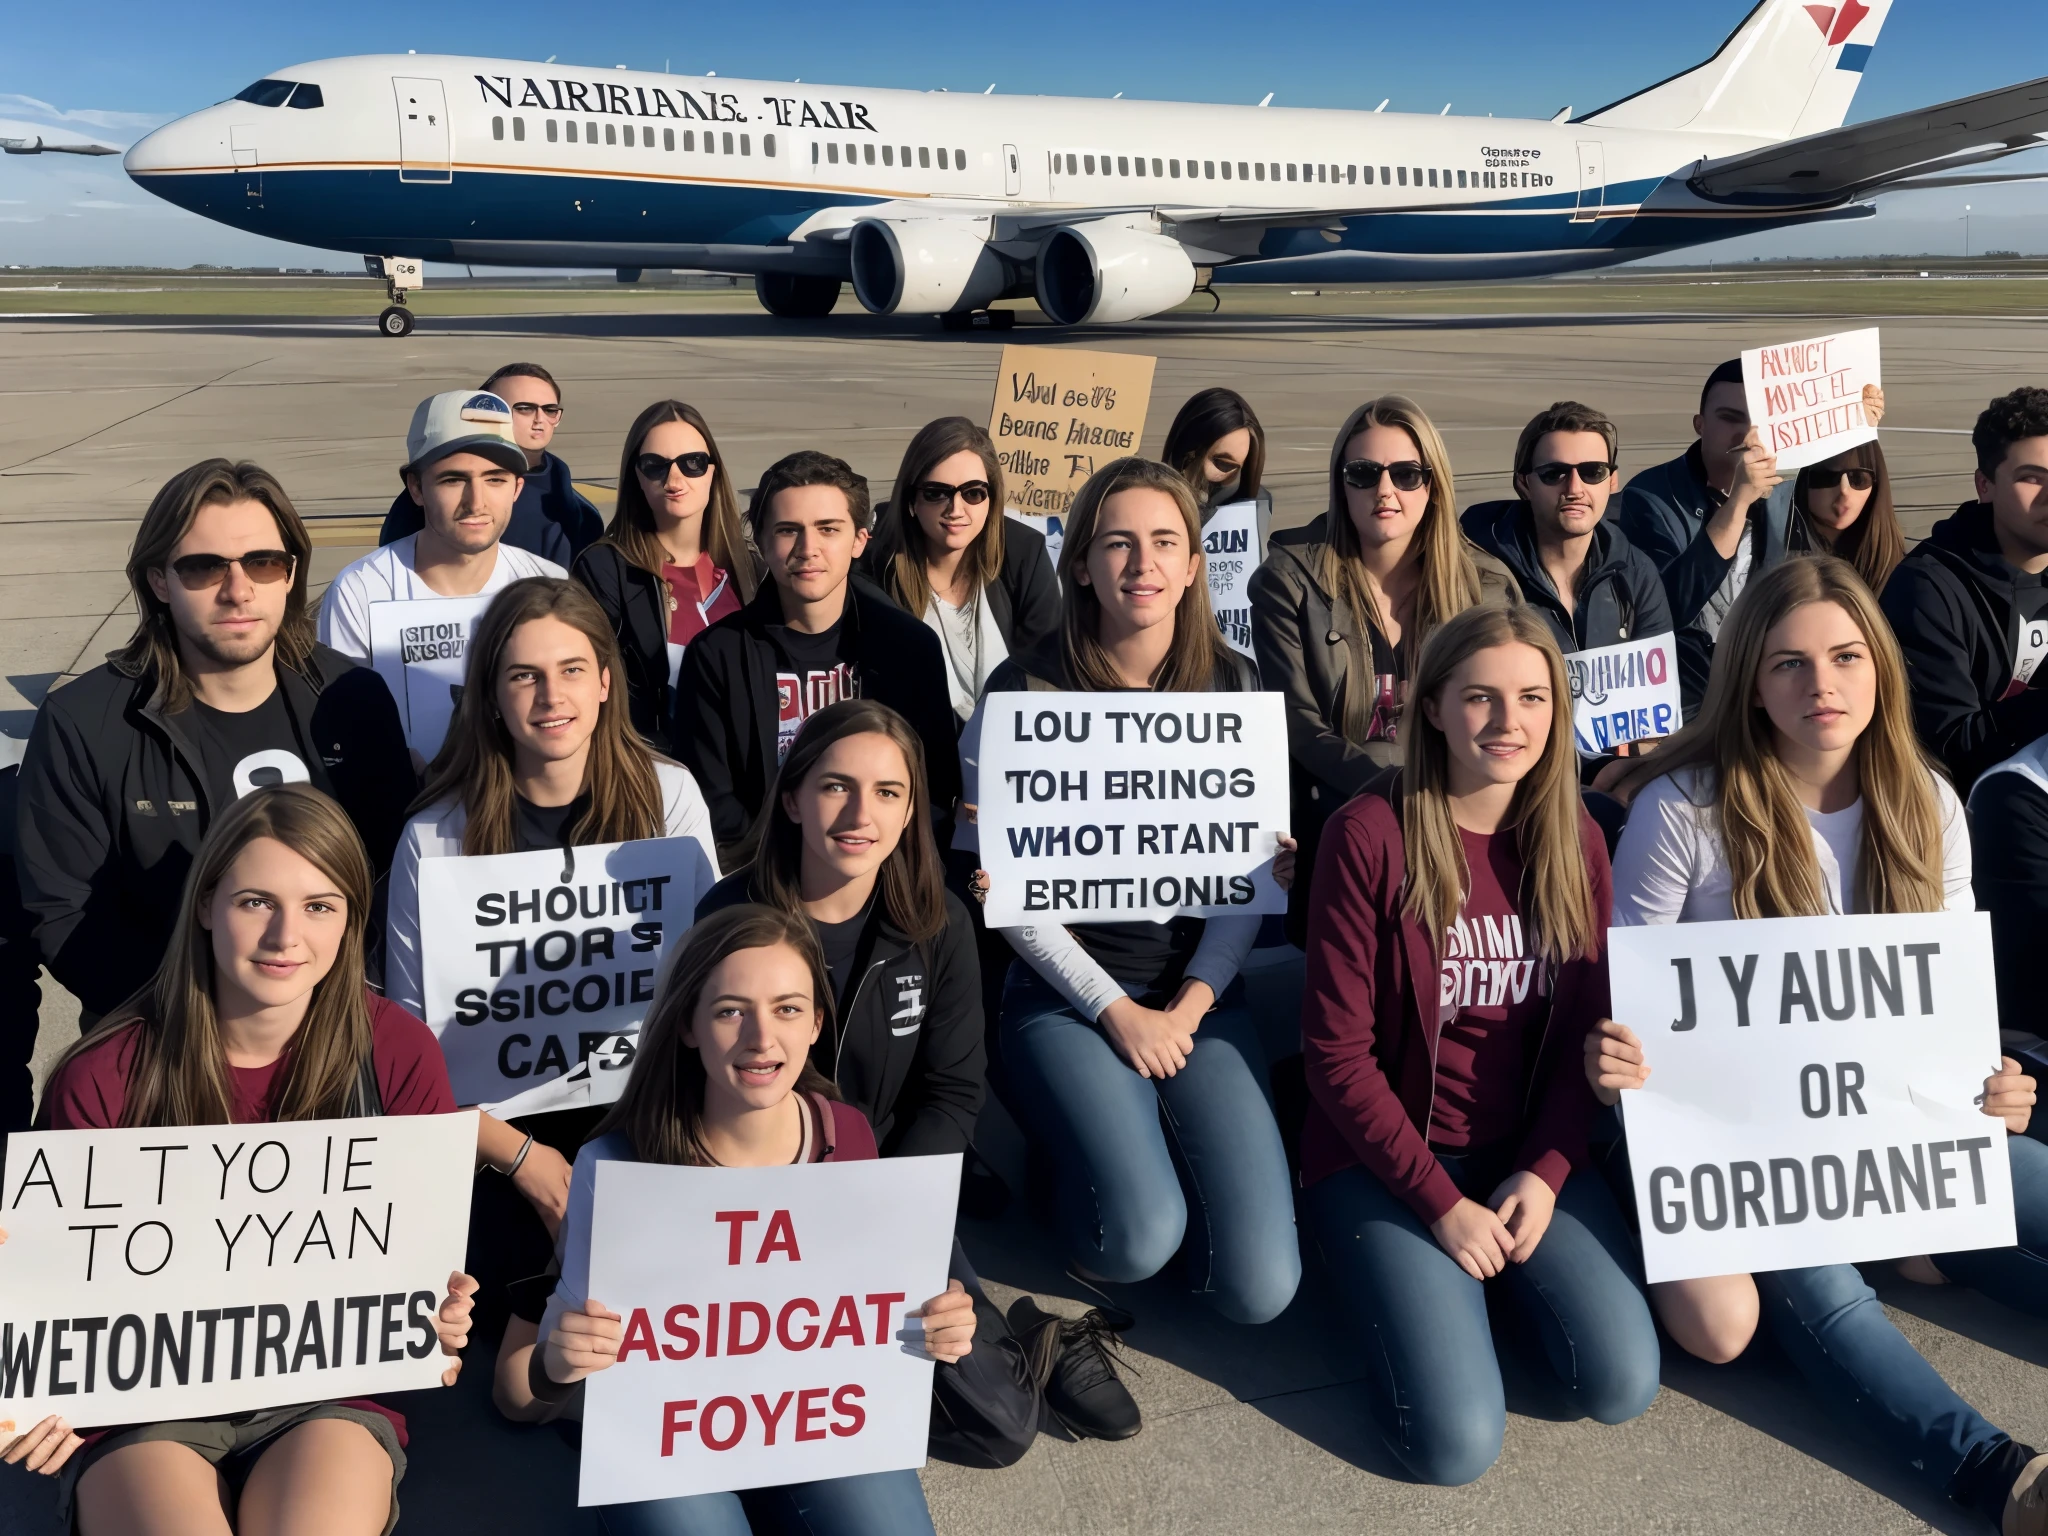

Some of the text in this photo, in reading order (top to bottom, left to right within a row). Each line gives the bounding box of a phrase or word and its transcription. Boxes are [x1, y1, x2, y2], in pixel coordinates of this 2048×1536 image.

[1014, 711, 1242, 743] LOU TYOUR
[1005, 770, 1088, 803] TOH
[1799, 1061, 1868, 1119] OR
[1649, 1136, 1992, 1235] GORDOANET
[68, 1202, 393, 1282] TO YYAN
[715, 1209, 801, 1266] TA
[615, 1292, 906, 1362] ASIDGAT
[660, 1383, 866, 1457] FOYES
